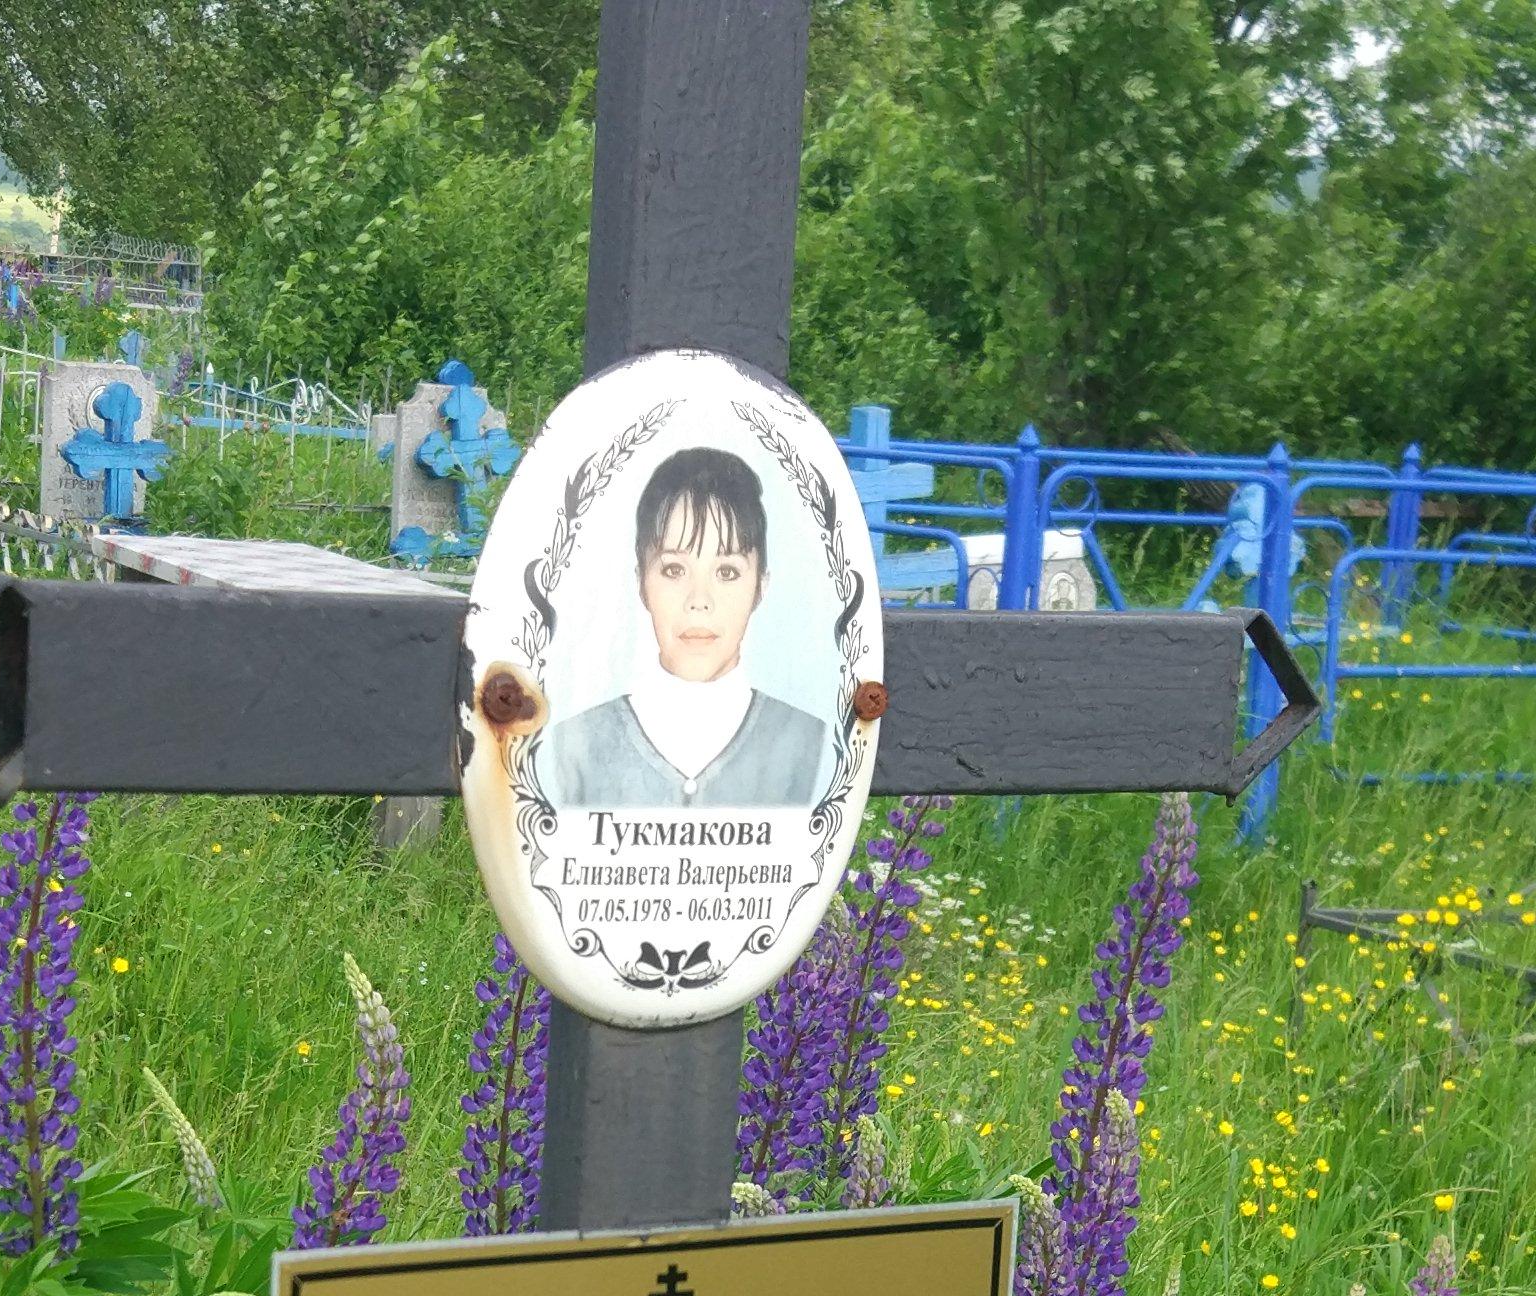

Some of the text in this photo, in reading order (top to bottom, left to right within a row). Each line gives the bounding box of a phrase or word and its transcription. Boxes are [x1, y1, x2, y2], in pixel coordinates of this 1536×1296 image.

[588, 811, 772, 856] Тукмакова
[561, 857, 793, 893] Елизавета Валерьевна
[578, 898, 672, 923] 07.05.1978
[688, 897, 772, 922] 06.03.2011
